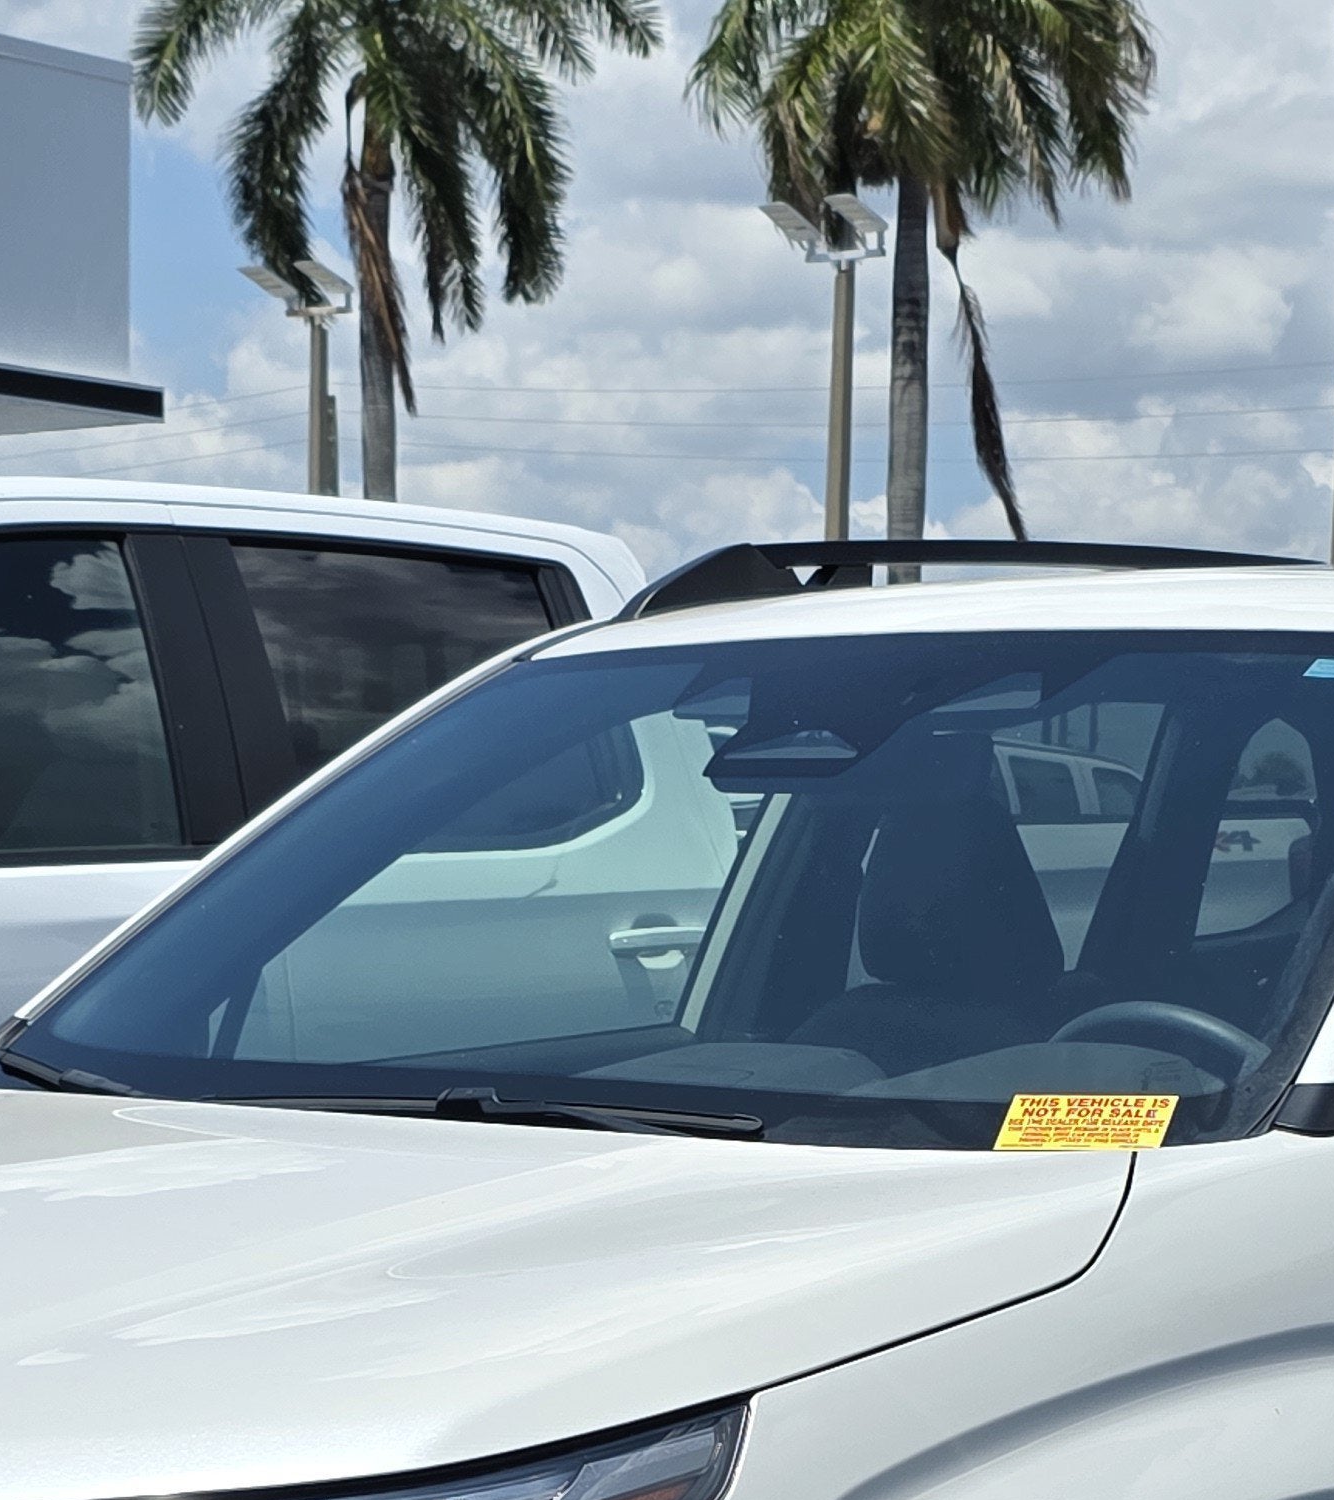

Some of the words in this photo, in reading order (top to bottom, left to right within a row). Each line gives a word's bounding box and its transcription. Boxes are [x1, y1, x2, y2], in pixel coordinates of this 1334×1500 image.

[1019, 1098, 1059, 1107] THIS
[1067, 1097, 1146, 1107] VEHICLE
[1152, 1098, 1170, 1108] IS
[1022, 1108, 1061, 1117] NOT
[1065, 1108, 1103, 1117] FOR
[1109, 1108, 1158, 1118] SALE
